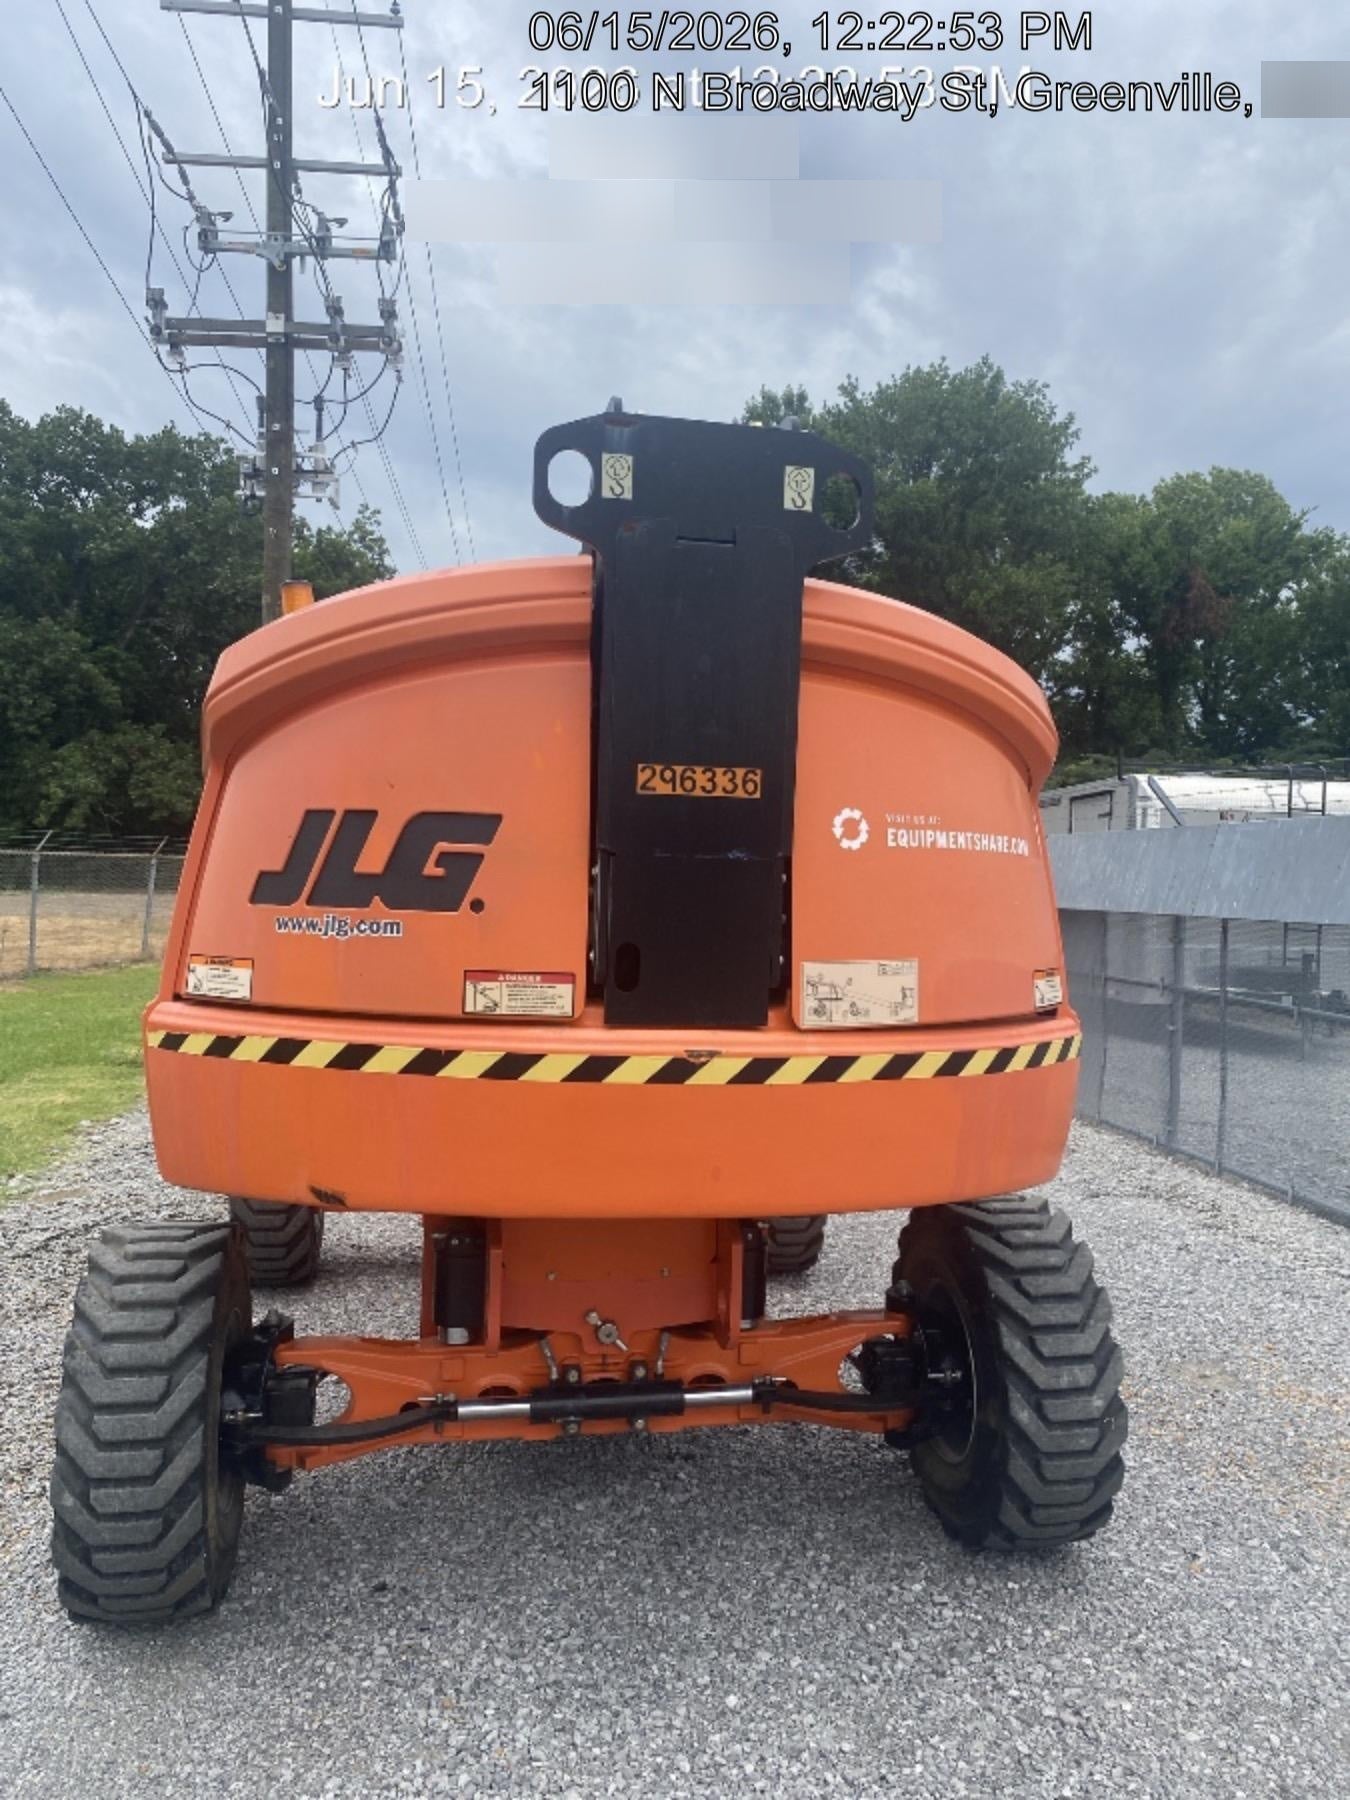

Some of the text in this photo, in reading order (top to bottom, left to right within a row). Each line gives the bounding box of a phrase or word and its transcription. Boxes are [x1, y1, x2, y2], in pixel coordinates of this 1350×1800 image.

[639, 764, 759, 797] 296336
[886, 828, 1029, 857] EQUIPMENTSHARE.COM
[275, 913, 402, 940] www.jlg.com
